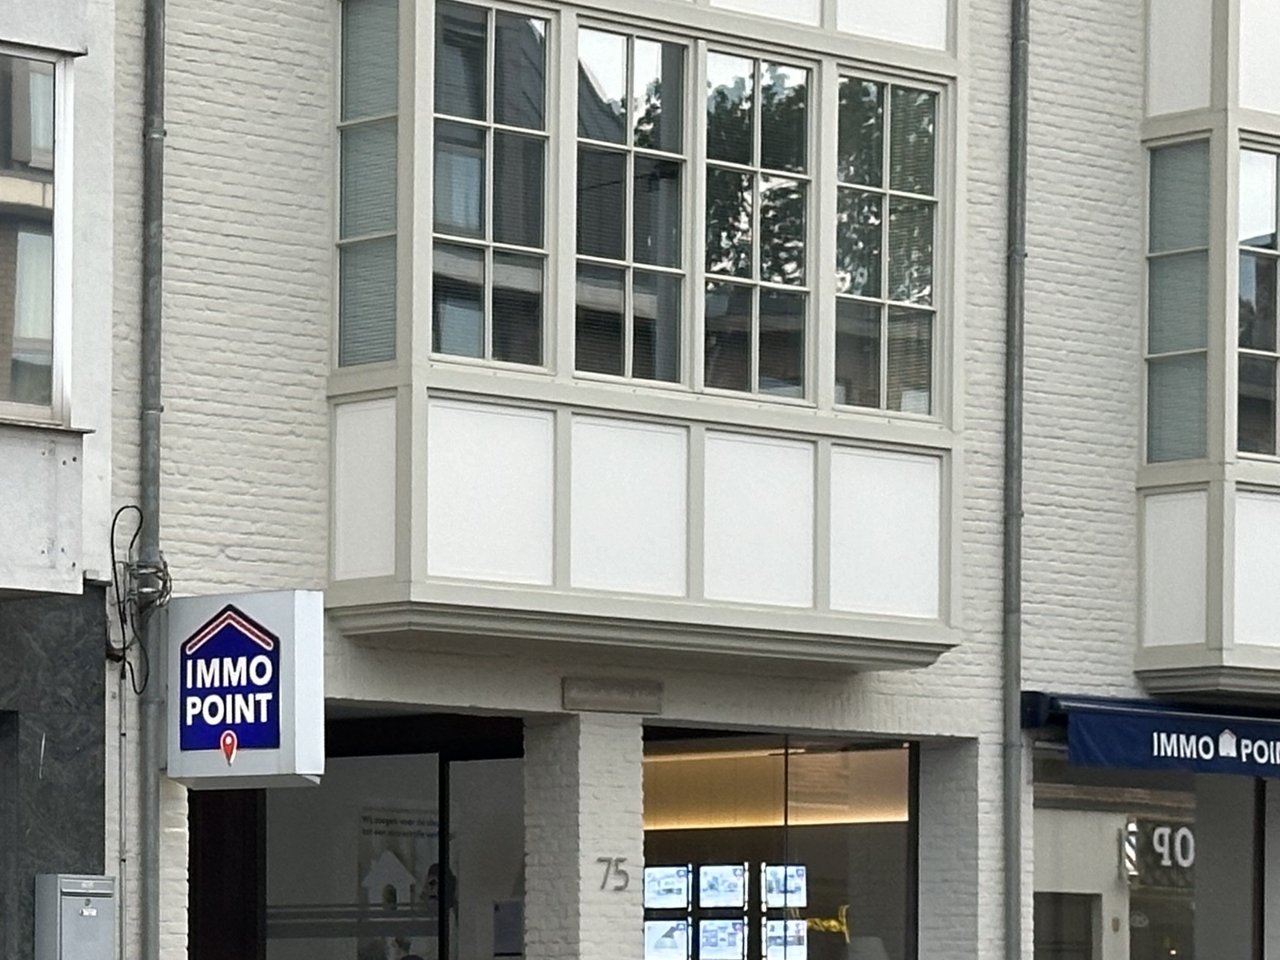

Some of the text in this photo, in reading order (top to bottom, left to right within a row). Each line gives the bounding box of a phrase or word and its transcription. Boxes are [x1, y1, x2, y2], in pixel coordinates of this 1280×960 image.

[186, 655, 273, 689] IMMO
[186, 692, 273, 726] POINT
[1152, 731, 1215, 760] IMMO
[596, 856, 630, 891] 75
